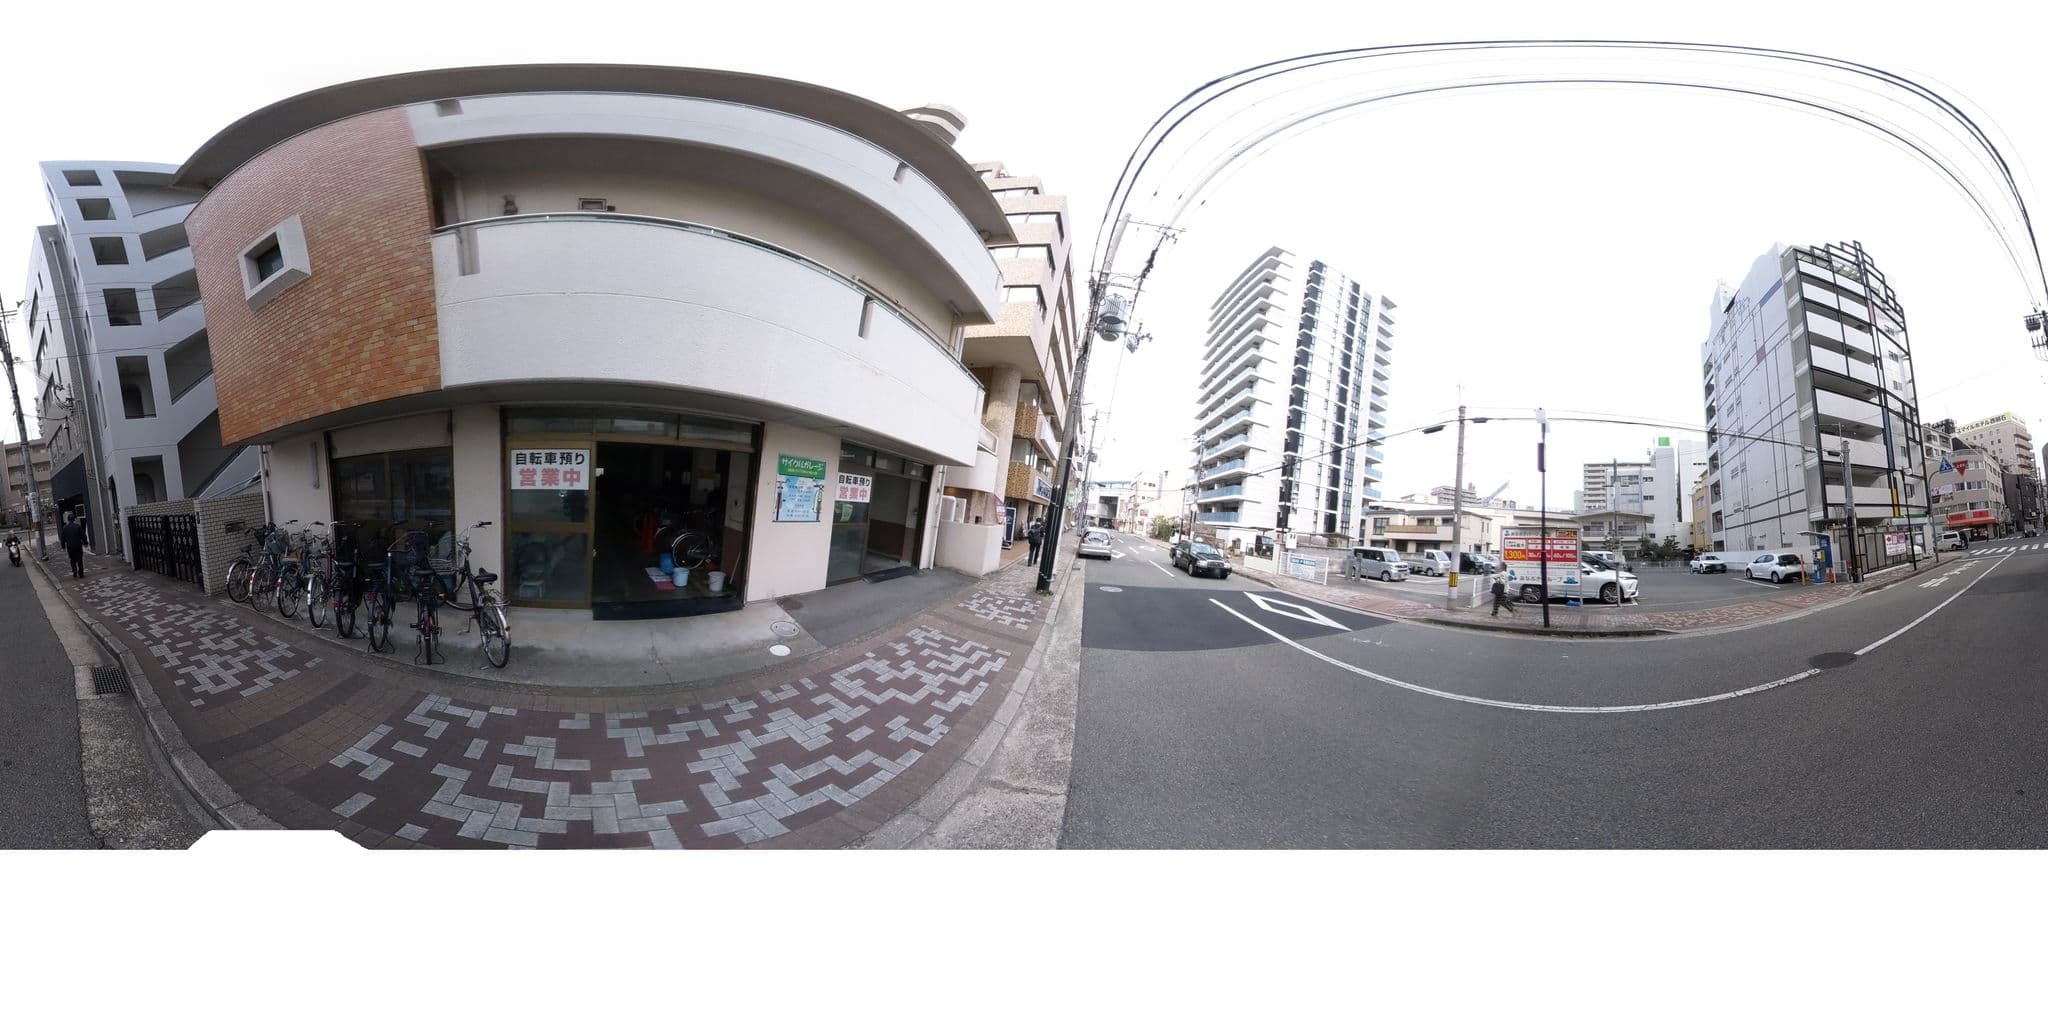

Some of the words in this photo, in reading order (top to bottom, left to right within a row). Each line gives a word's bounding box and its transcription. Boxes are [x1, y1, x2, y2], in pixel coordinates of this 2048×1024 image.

[515, 452, 585, 465] 自転車預り
[519, 467, 581, 487] 営業中
[838, 474, 871, 487] 自転車預り
[839, 486, 868, 500] 営業中
